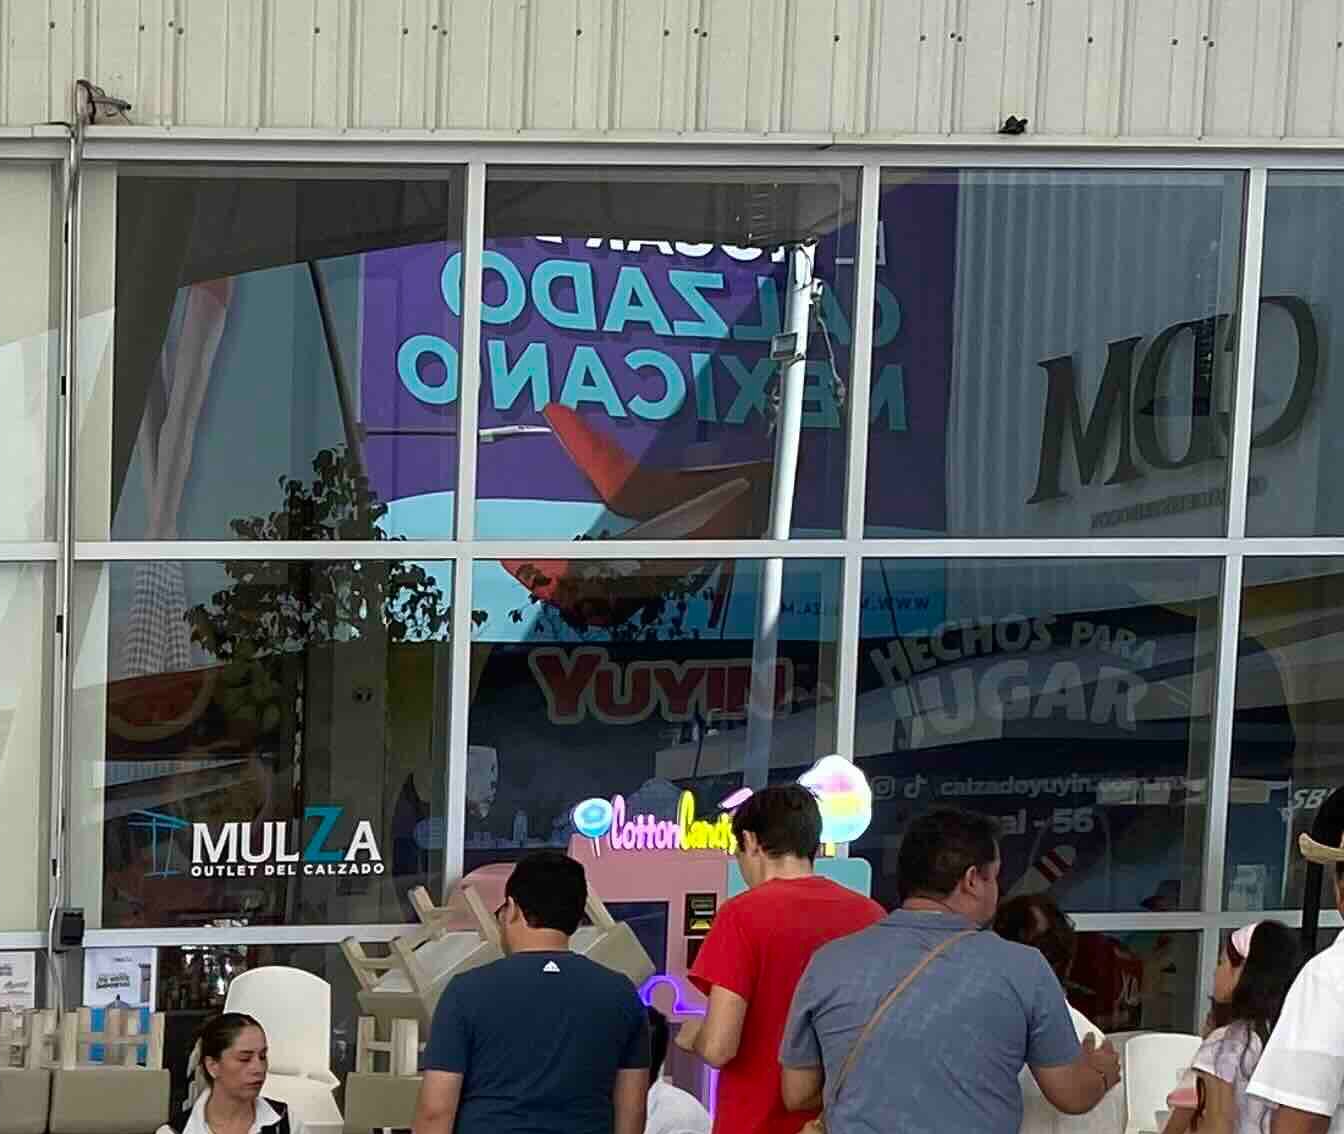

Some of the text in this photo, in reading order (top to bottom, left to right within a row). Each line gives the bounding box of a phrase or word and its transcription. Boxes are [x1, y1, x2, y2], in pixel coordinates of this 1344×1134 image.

[870, 615, 1158, 686] HECHOS PARA
[528, 646, 797, 725] YUYIN
[890, 660, 1150, 753] JUGAR
[191, 805, 382, 864] MULZA
[610, 794, 680, 851] Cotton
[191, 862, 385, 877] OUTLET DEL CALZADO
